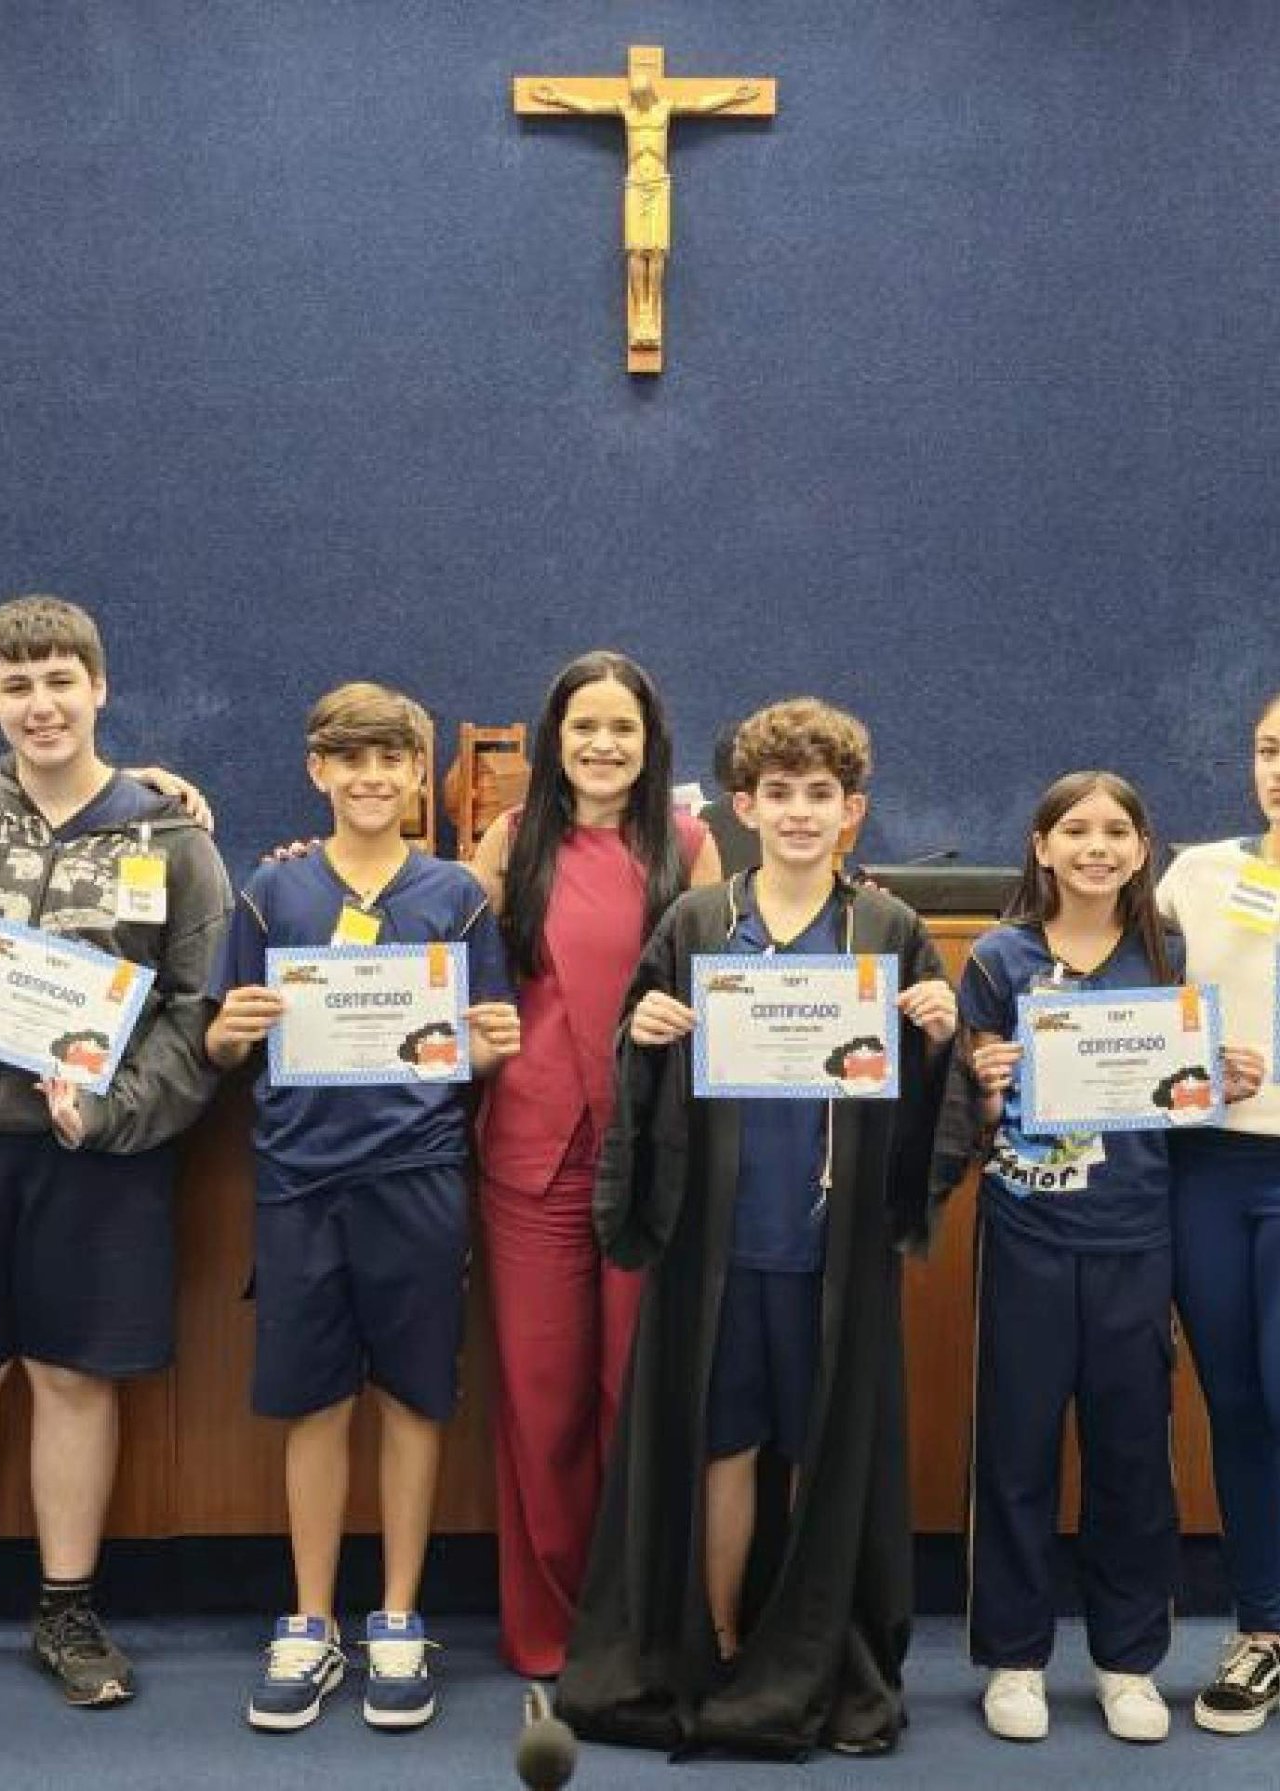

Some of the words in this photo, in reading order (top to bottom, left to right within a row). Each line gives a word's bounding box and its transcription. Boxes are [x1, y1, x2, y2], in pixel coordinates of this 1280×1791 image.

[6, 969, 87, 1007] CERTIFICADO
[325, 991, 413, 1009] CERTIFICADO
[751, 1003, 841, 1019] CERTIFICADO
[1077, 1035, 1166, 1056] CERTIFICADO
